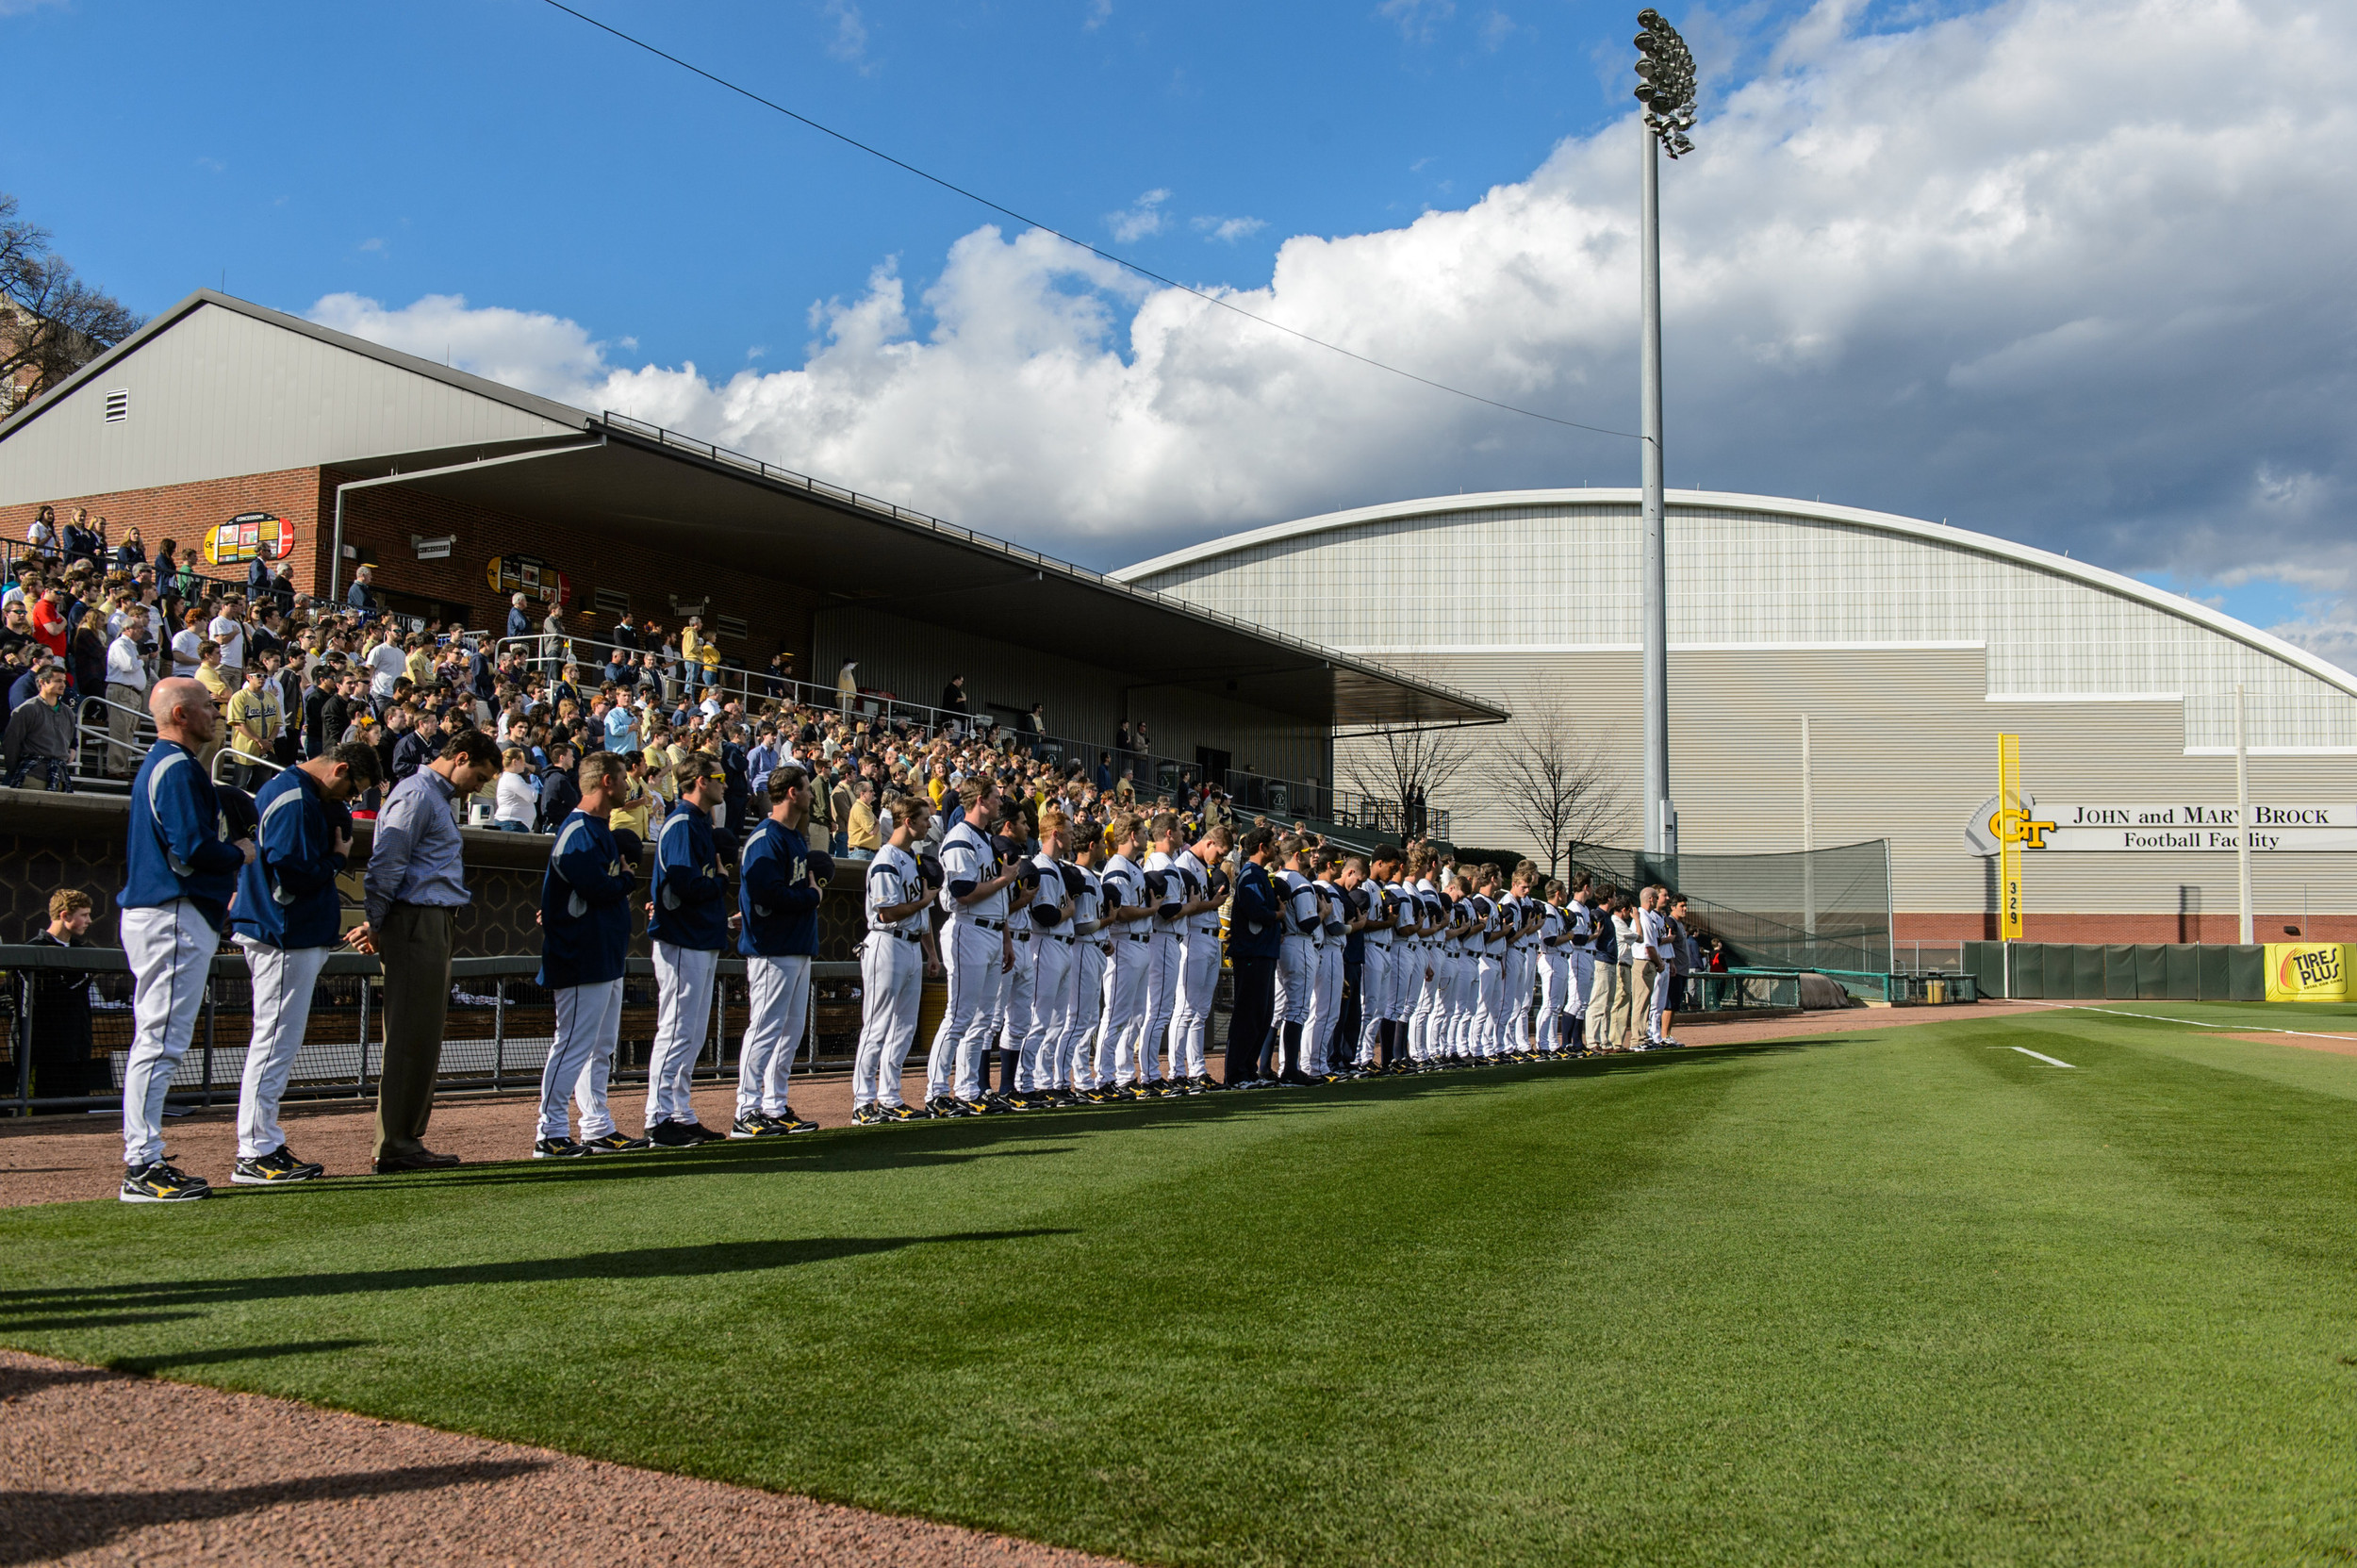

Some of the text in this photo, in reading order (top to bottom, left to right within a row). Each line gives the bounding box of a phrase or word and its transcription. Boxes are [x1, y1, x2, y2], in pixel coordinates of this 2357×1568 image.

[236, 514, 265, 522] CONCESSIONS
[2073, 807, 2130, 824] JOHN
[2138, 809, 2175, 824] and
[2255, 806, 2330, 824] BROCK
[2124, 833, 2280, 850] Football Faclity
[2293, 948, 2337, 971] TIRES
[2300, 963, 2340, 986] PLUS
